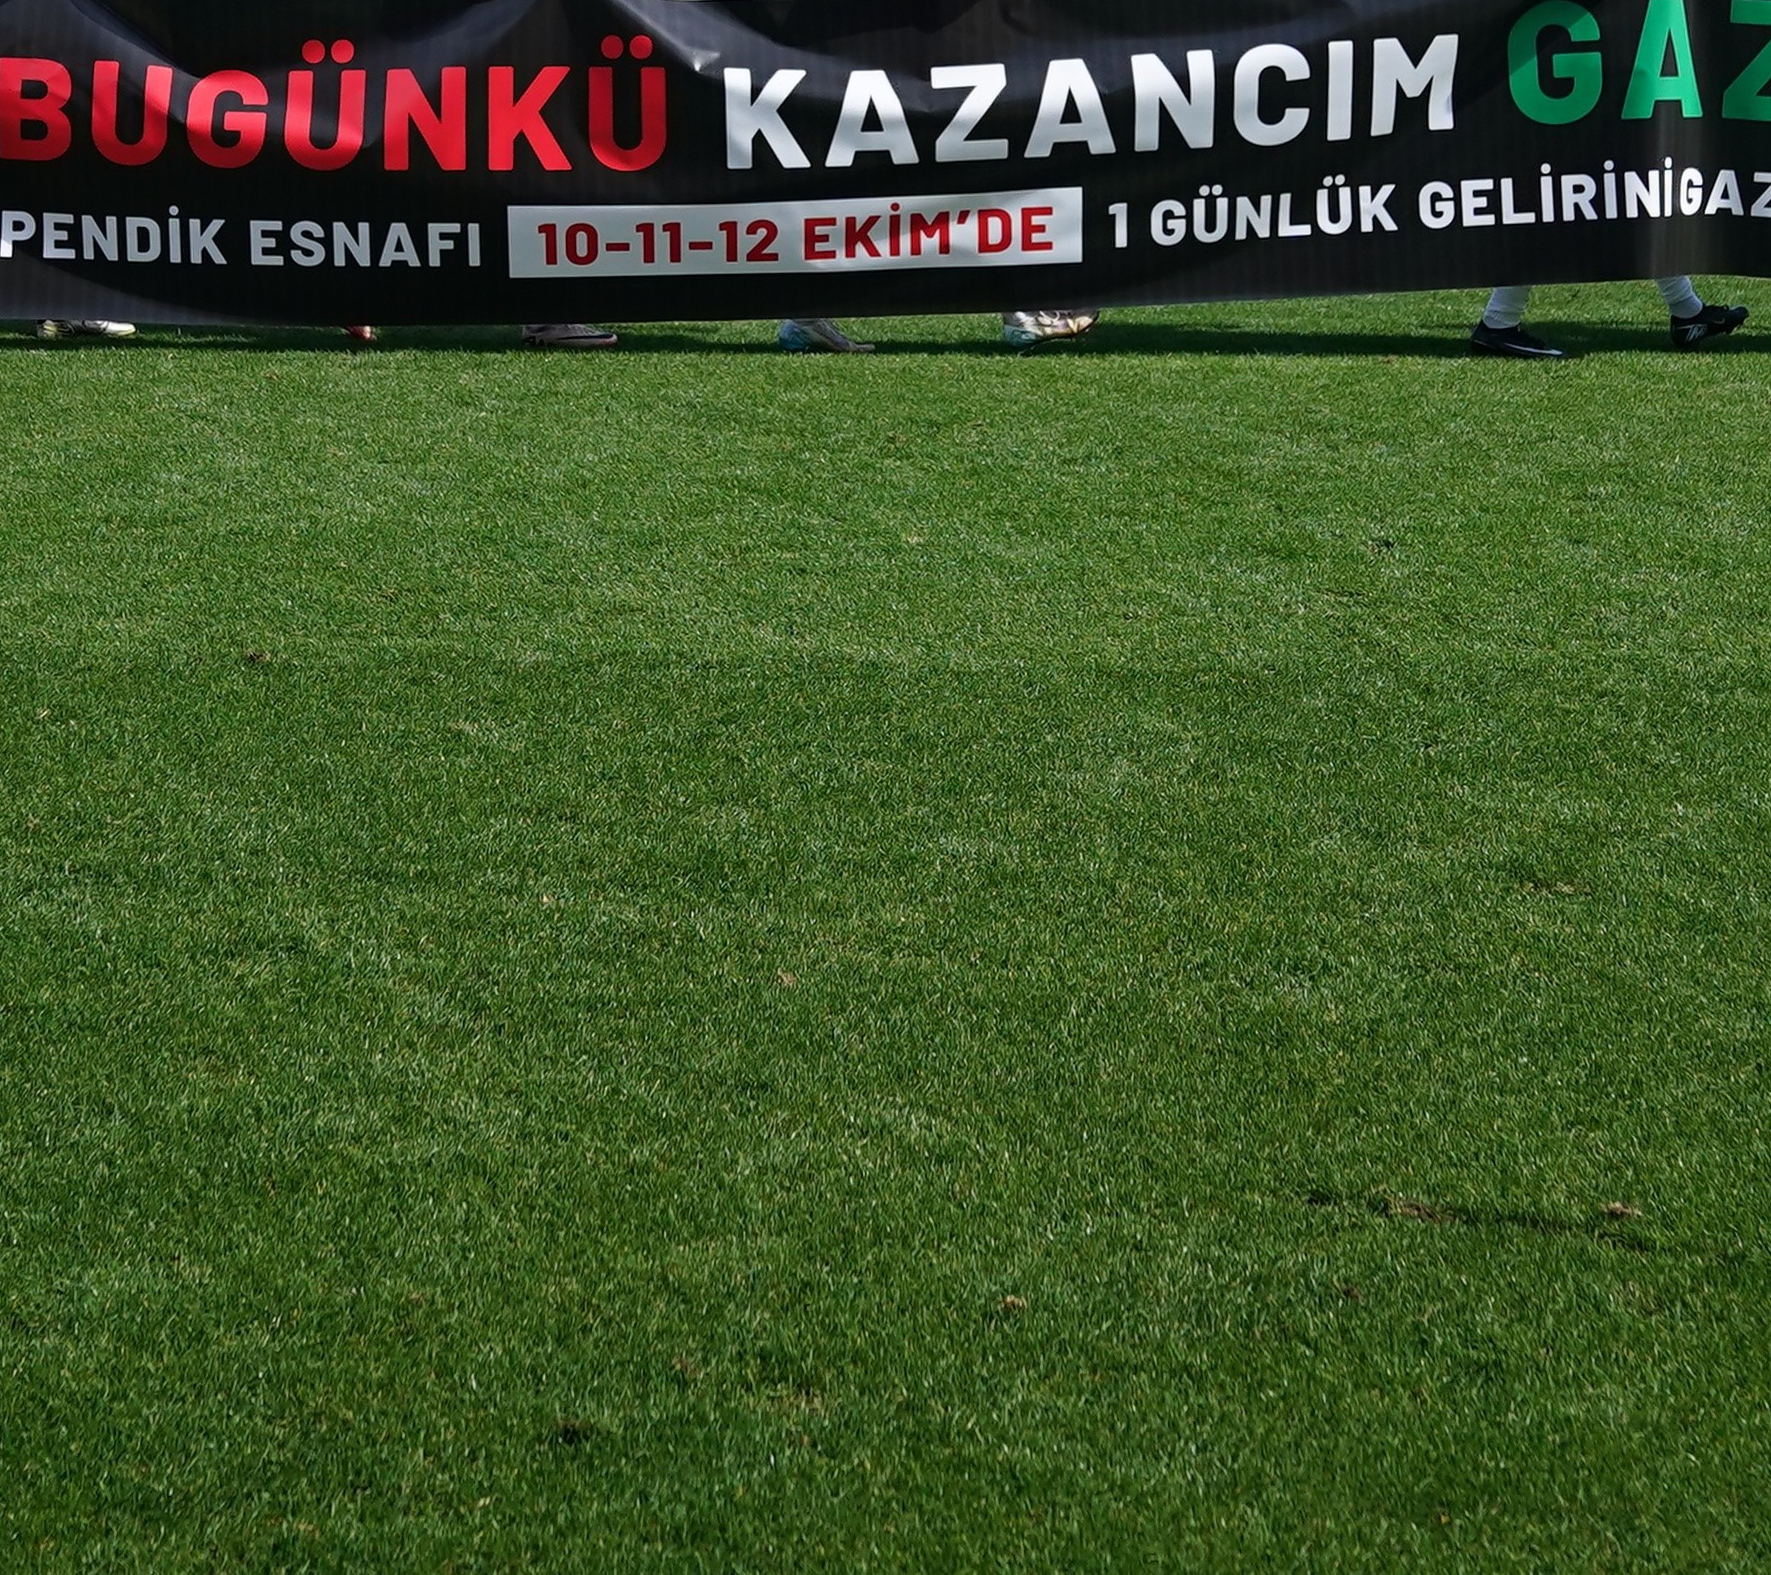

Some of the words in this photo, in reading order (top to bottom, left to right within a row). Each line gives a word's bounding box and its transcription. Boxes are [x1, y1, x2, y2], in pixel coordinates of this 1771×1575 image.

[723, 32, 1461, 171] KAZANCIM
[0, 204, 227, 267] PENDİK
[249, 219, 482, 268] ESNAFI
[536, 217, 780, 267] 10-11-12
[802, 202, 1055, 261] EKİM'DE
[1107, 201, 1129, 249] 1
[1150, 174, 1399, 247] GÜNLÜK
